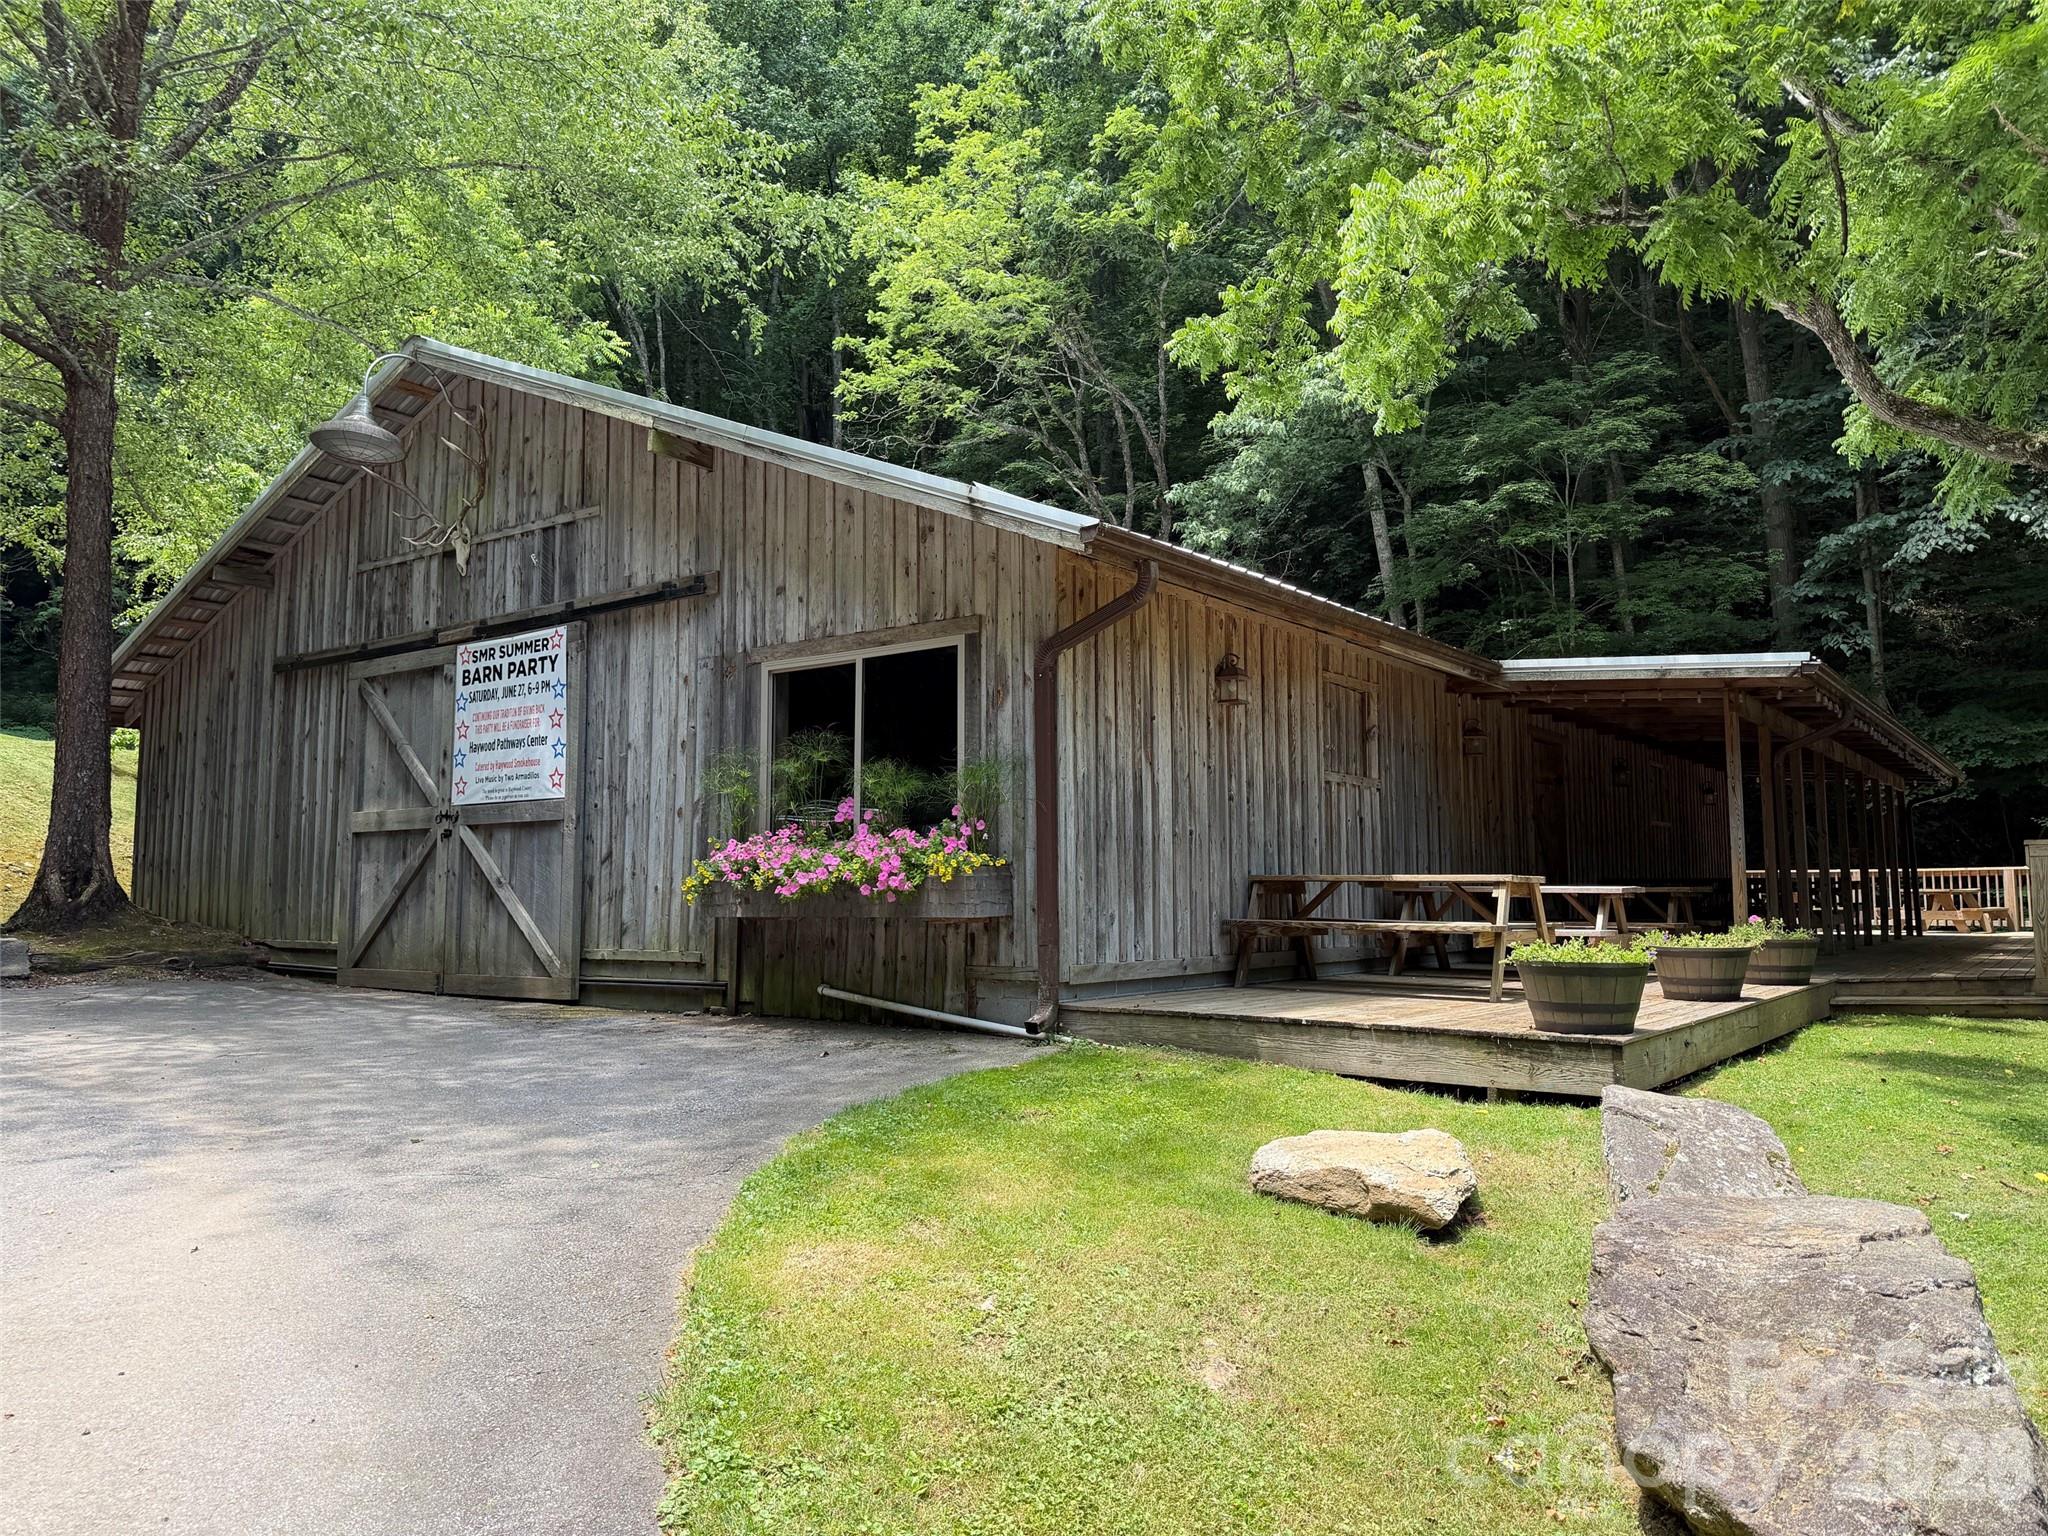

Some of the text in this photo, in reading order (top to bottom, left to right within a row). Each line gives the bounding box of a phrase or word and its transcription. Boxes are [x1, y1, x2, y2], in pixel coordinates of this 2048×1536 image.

[472, 638, 549, 663] SMR SUMMER
[462, 654, 559, 686] BARN PARTY
[468, 679, 551, 704] SATURDAY, JUNE 27, 6-9 PM
[535, 704, 545, 714] BACK
[483, 723, 493, 734] PARTY
[469, 733, 548, 754] Haywood Pathways Center
[474, 757, 541, 773] Catered by Haywood Smokehouse
[475, 771, 540, 784] Live Music by Two Armadillos
